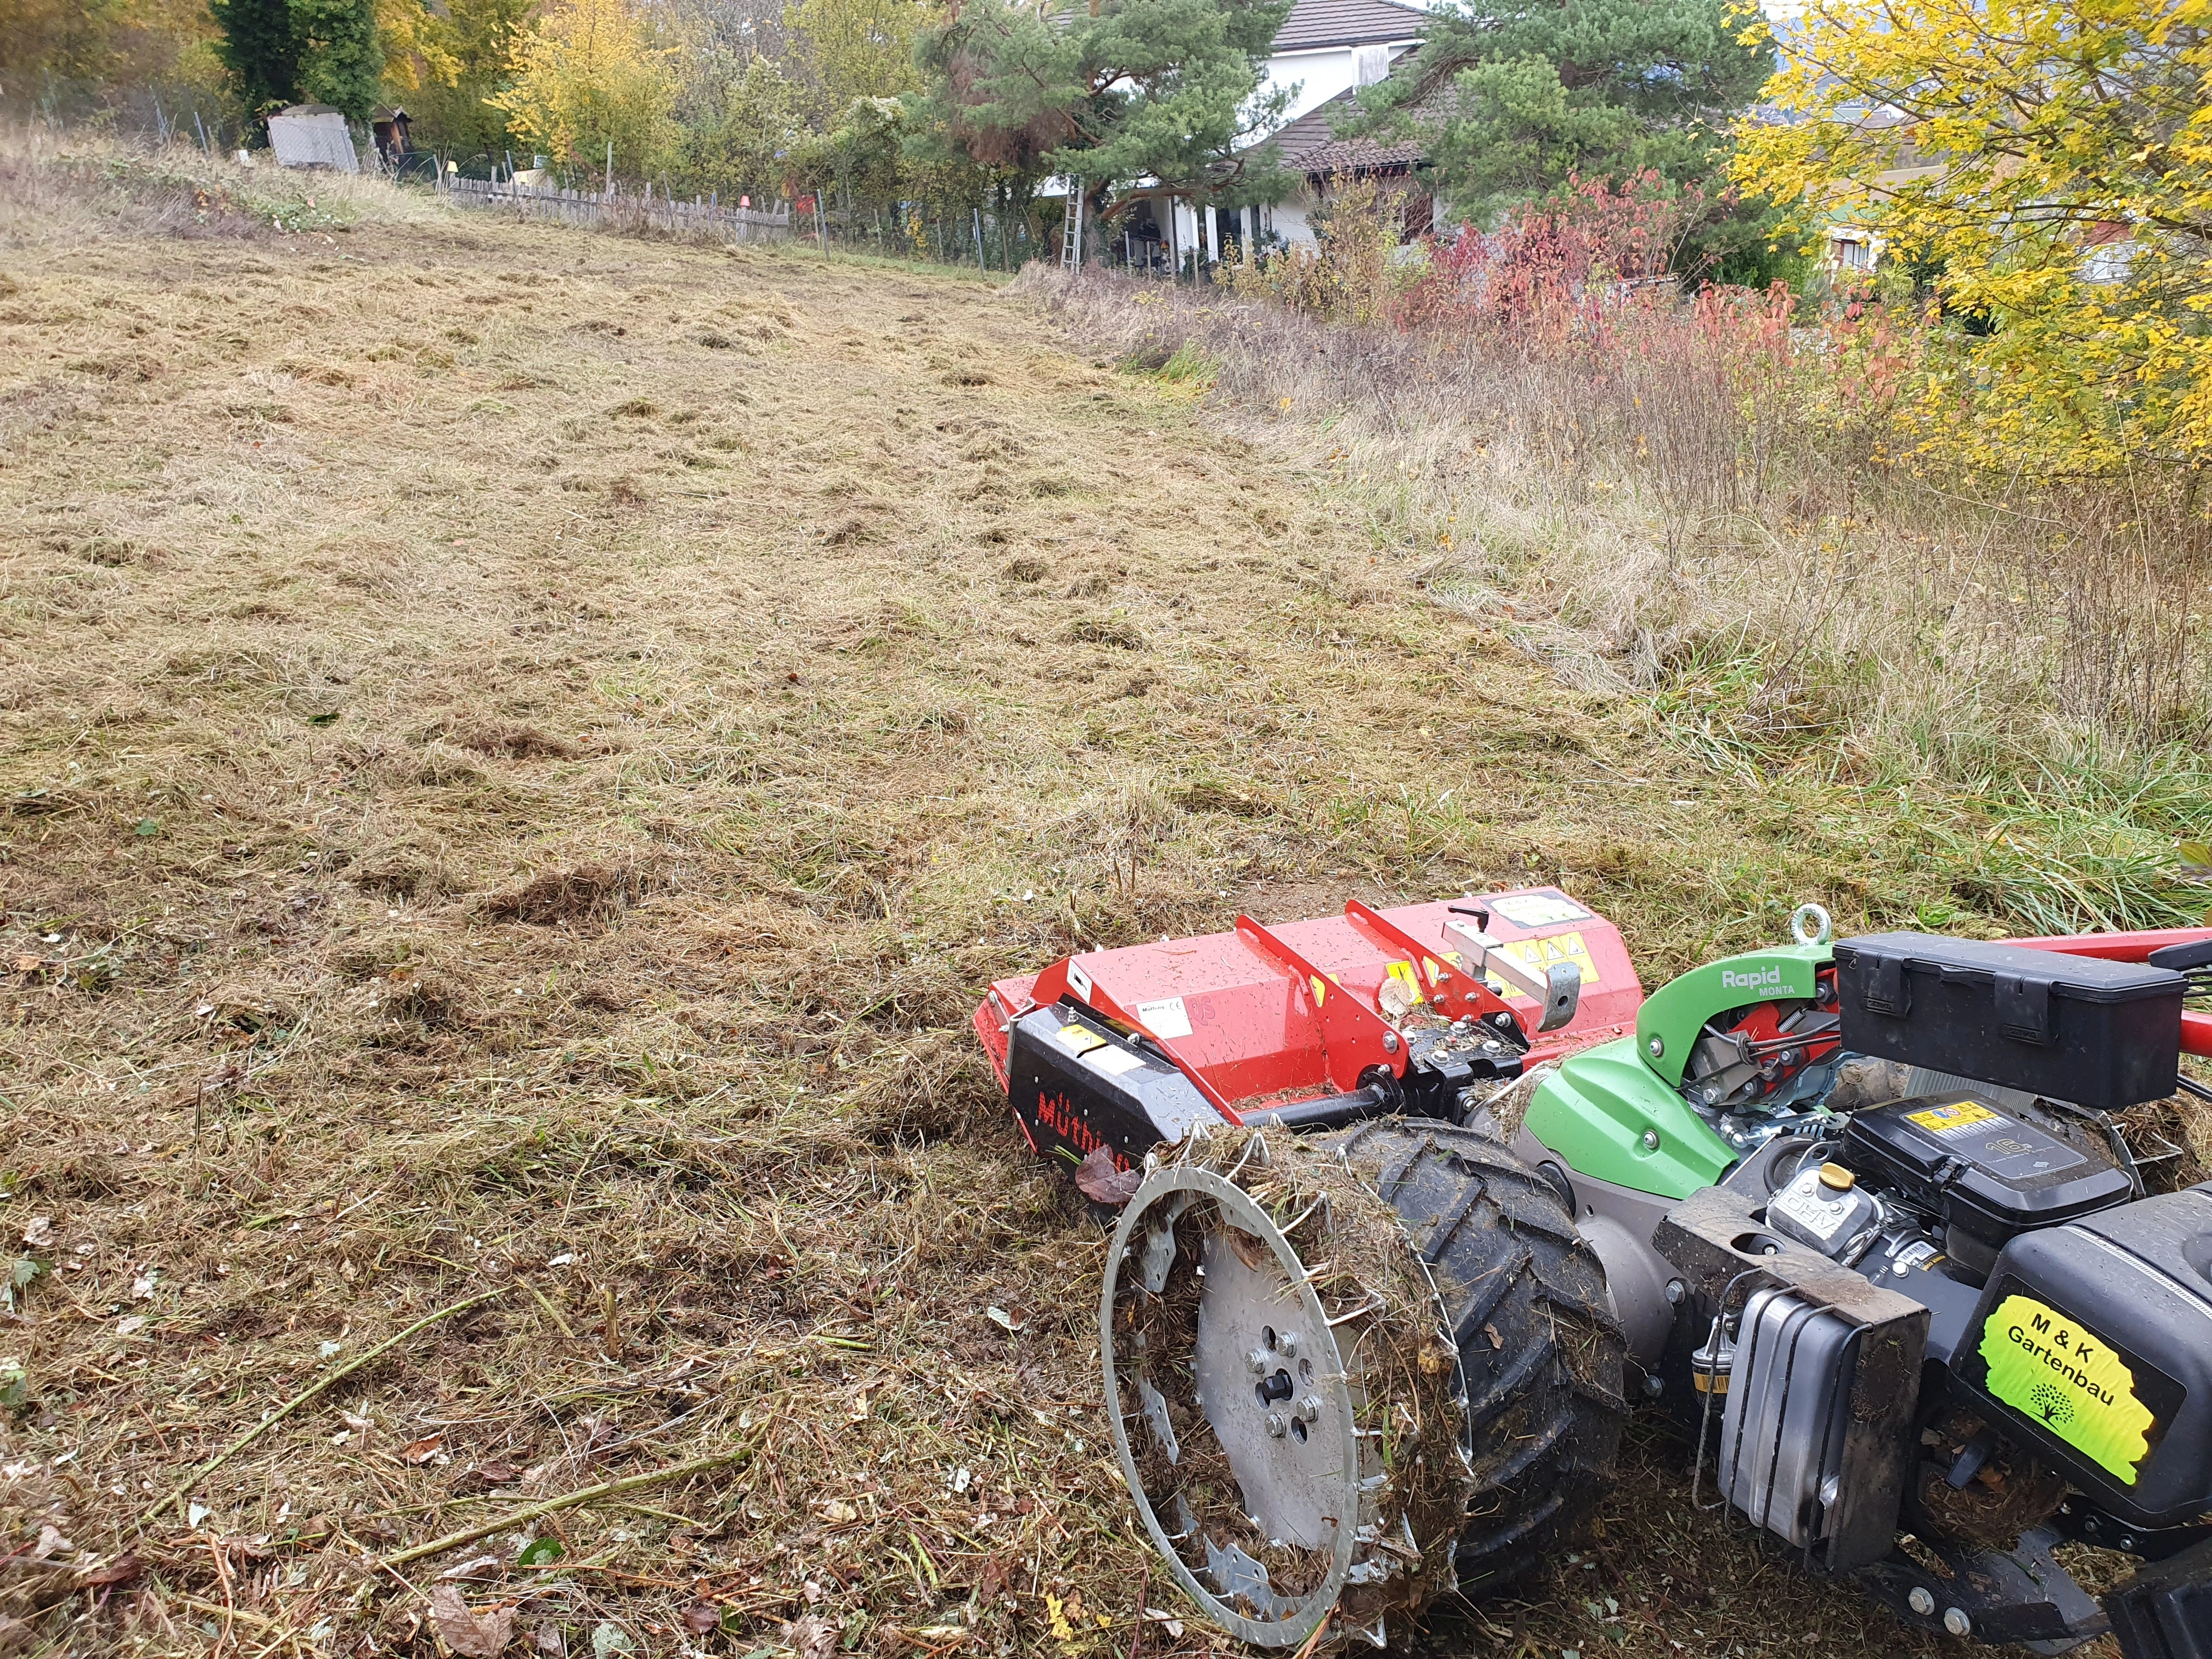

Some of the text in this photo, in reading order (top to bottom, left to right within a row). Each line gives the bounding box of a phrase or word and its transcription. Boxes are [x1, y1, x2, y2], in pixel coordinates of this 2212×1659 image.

[1722, 966, 1780, 990] Rapid
[1759, 985, 1795, 997] MONTA
[1933, 1116, 2017, 1142] VANGUARD
[1985, 1138, 2026, 1155] 16
[2030, 1313, 2094, 1364] M & K
[2008, 1325, 2114, 1407] Gartenbau
